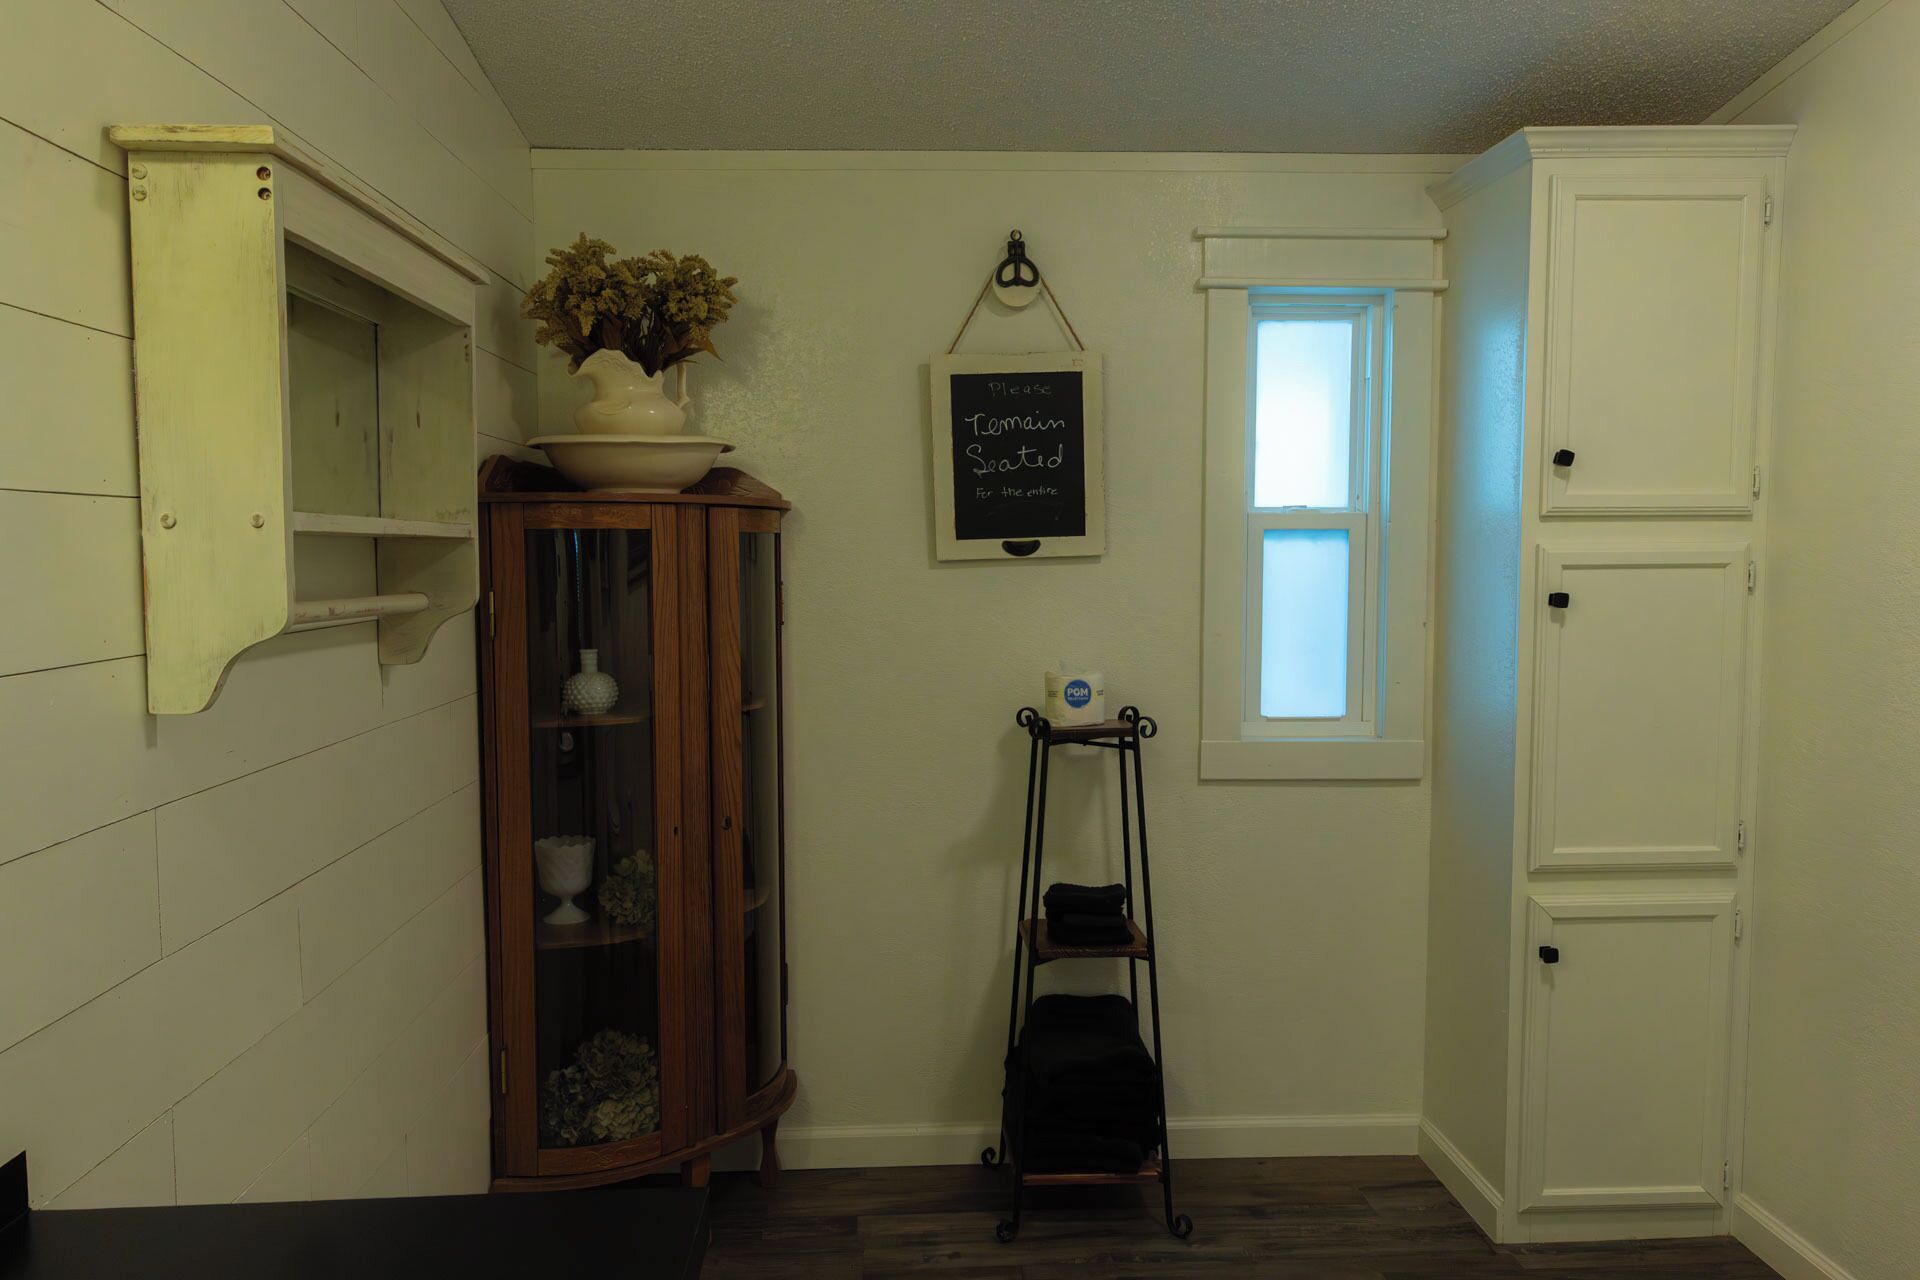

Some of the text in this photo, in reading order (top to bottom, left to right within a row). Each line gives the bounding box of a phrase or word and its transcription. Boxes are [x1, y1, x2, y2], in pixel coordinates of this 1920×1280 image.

[987, 381, 1052, 396] Please
[966, 443, 1064, 474] Seated
[976, 486, 1059, 499] For the entire
[1067, 687, 1089, 697] POM
